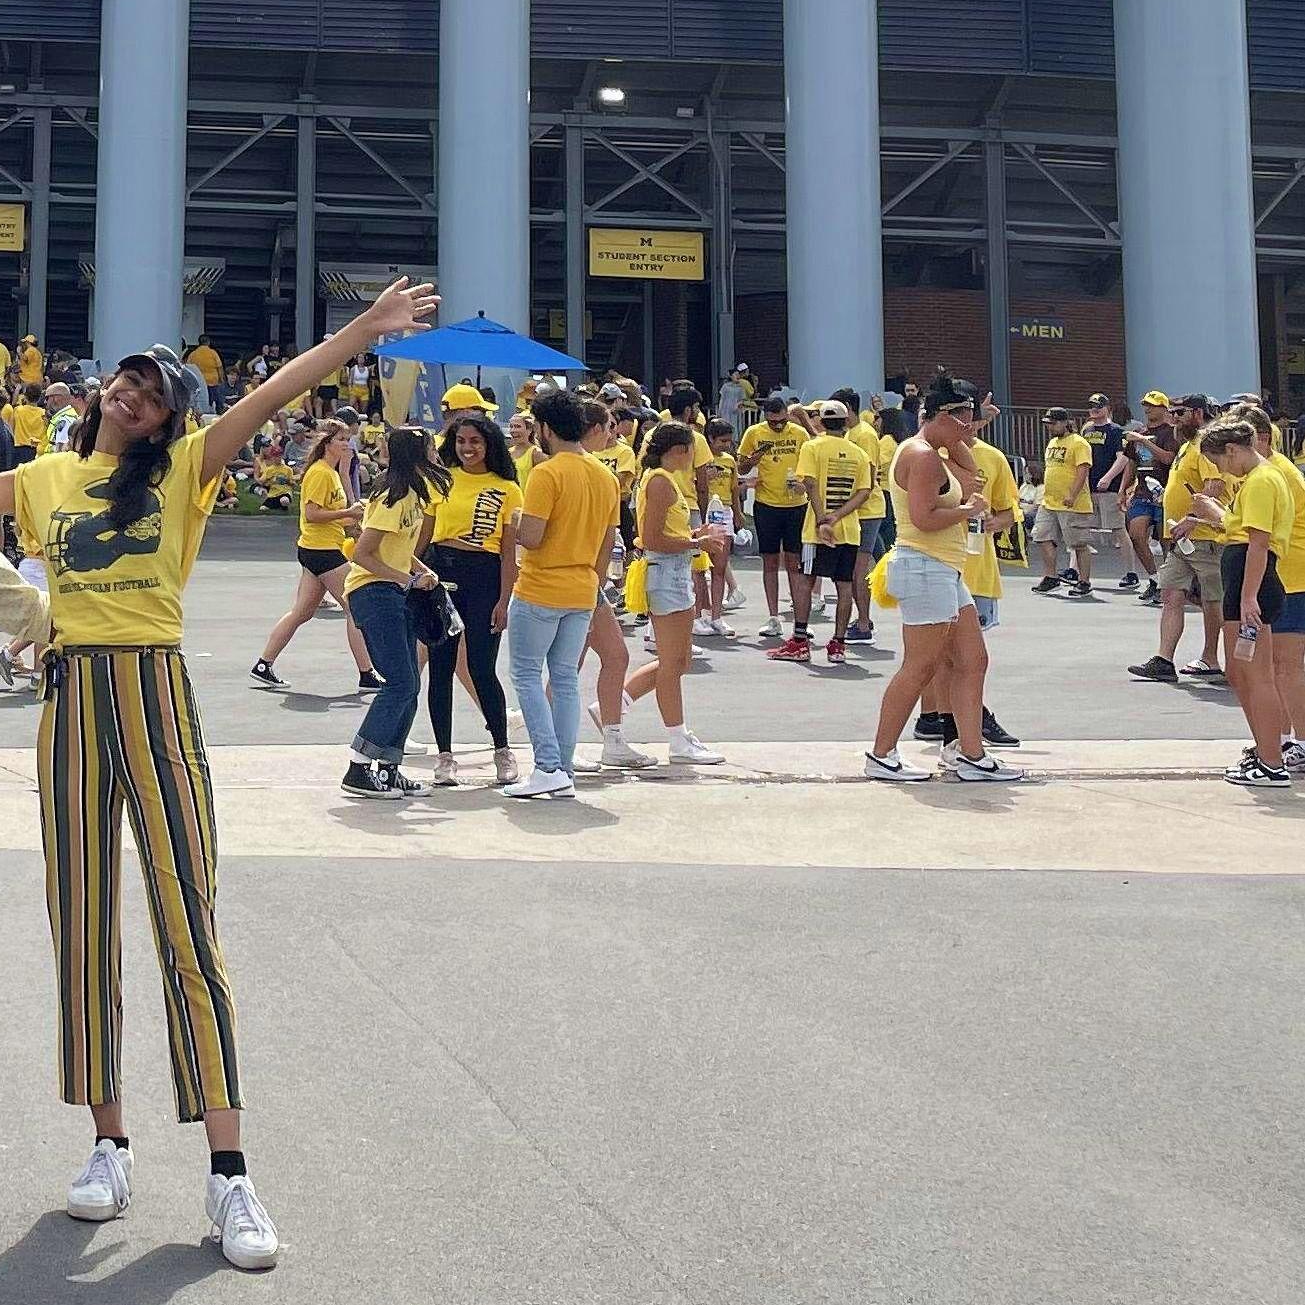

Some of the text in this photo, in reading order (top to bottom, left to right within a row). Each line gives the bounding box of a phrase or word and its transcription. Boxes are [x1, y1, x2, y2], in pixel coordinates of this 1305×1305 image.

[640, 237, 653, 247] M
[598, 251, 696, 263] STUDENT SECTION
[629, 263, 664, 272] ENTRY
[1022, 324, 1064, 338] MEN
